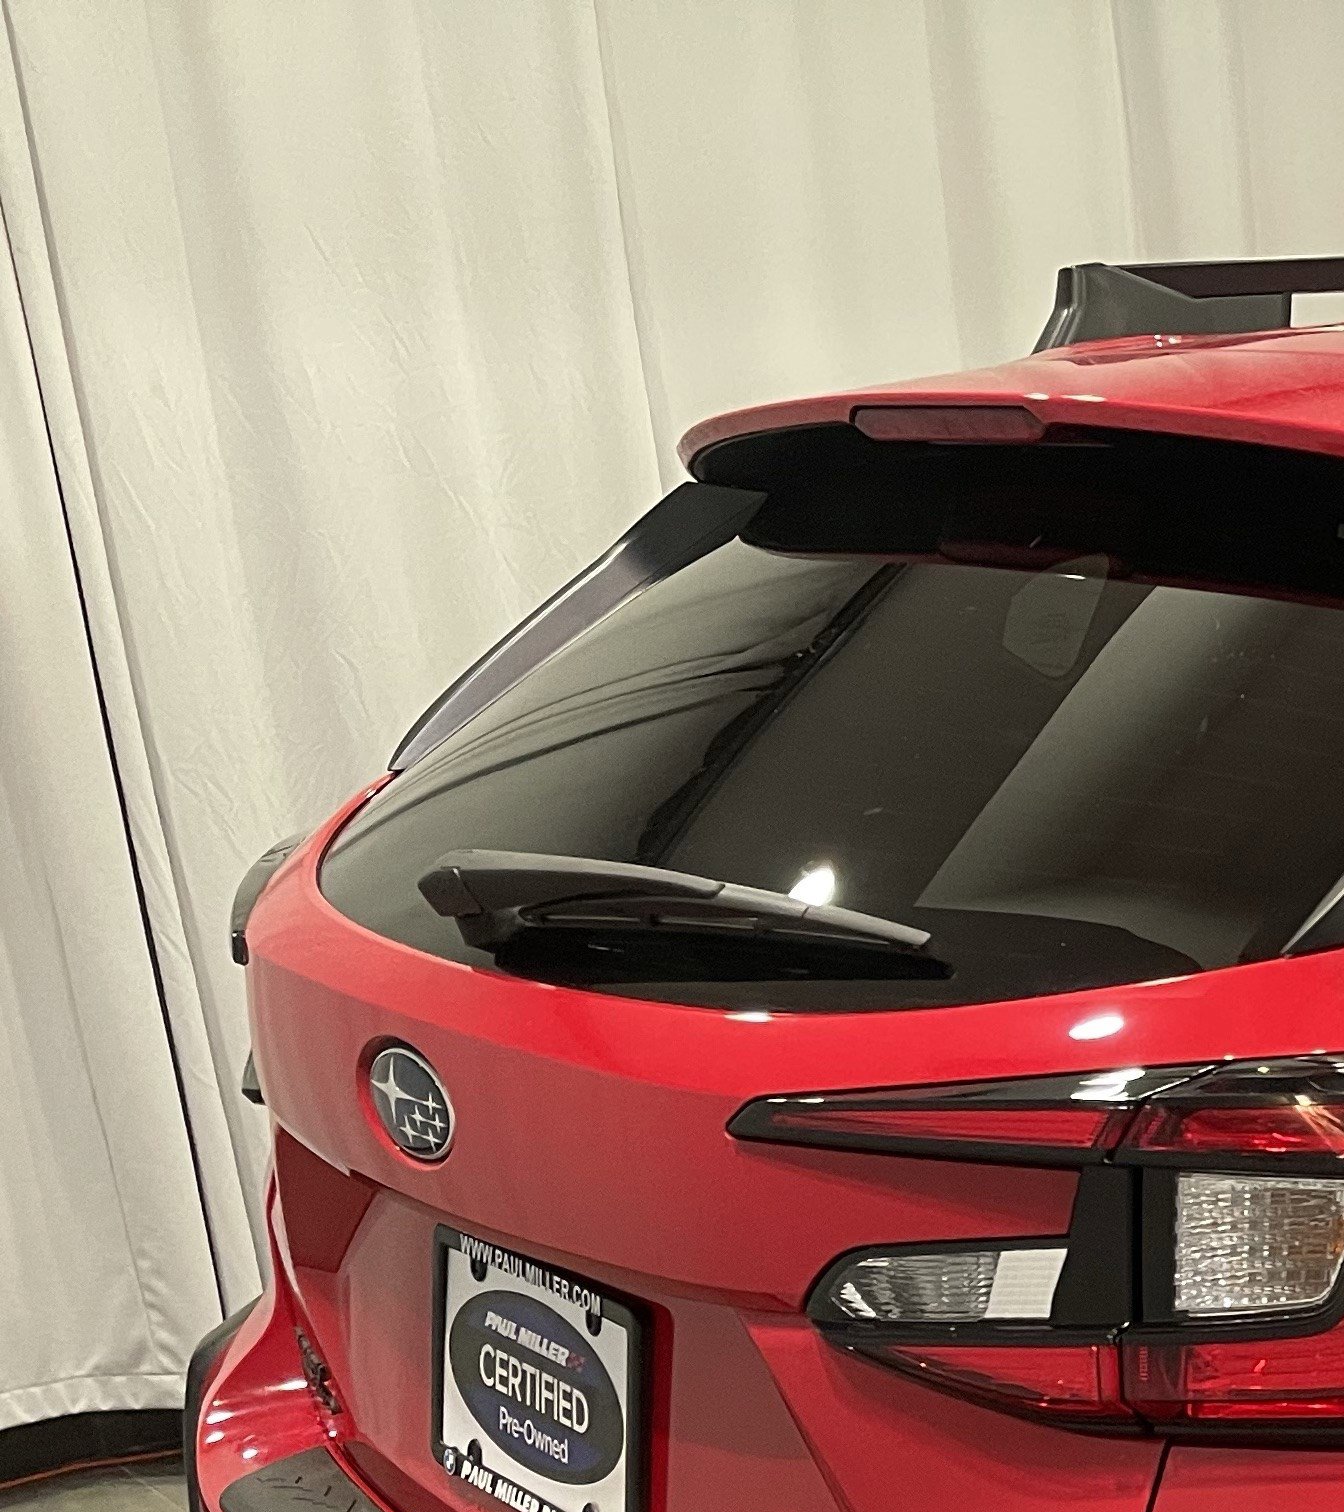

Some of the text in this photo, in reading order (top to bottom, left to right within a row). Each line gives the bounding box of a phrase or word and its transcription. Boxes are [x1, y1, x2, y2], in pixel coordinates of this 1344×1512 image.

[484, 1310, 571, 1367] PAUL MILLER
[479, 1343, 589, 1434] CERTIFIED
[499, 1405, 569, 1464] Pre-Owned
[460, 1459, 495, 1494] PAUL
